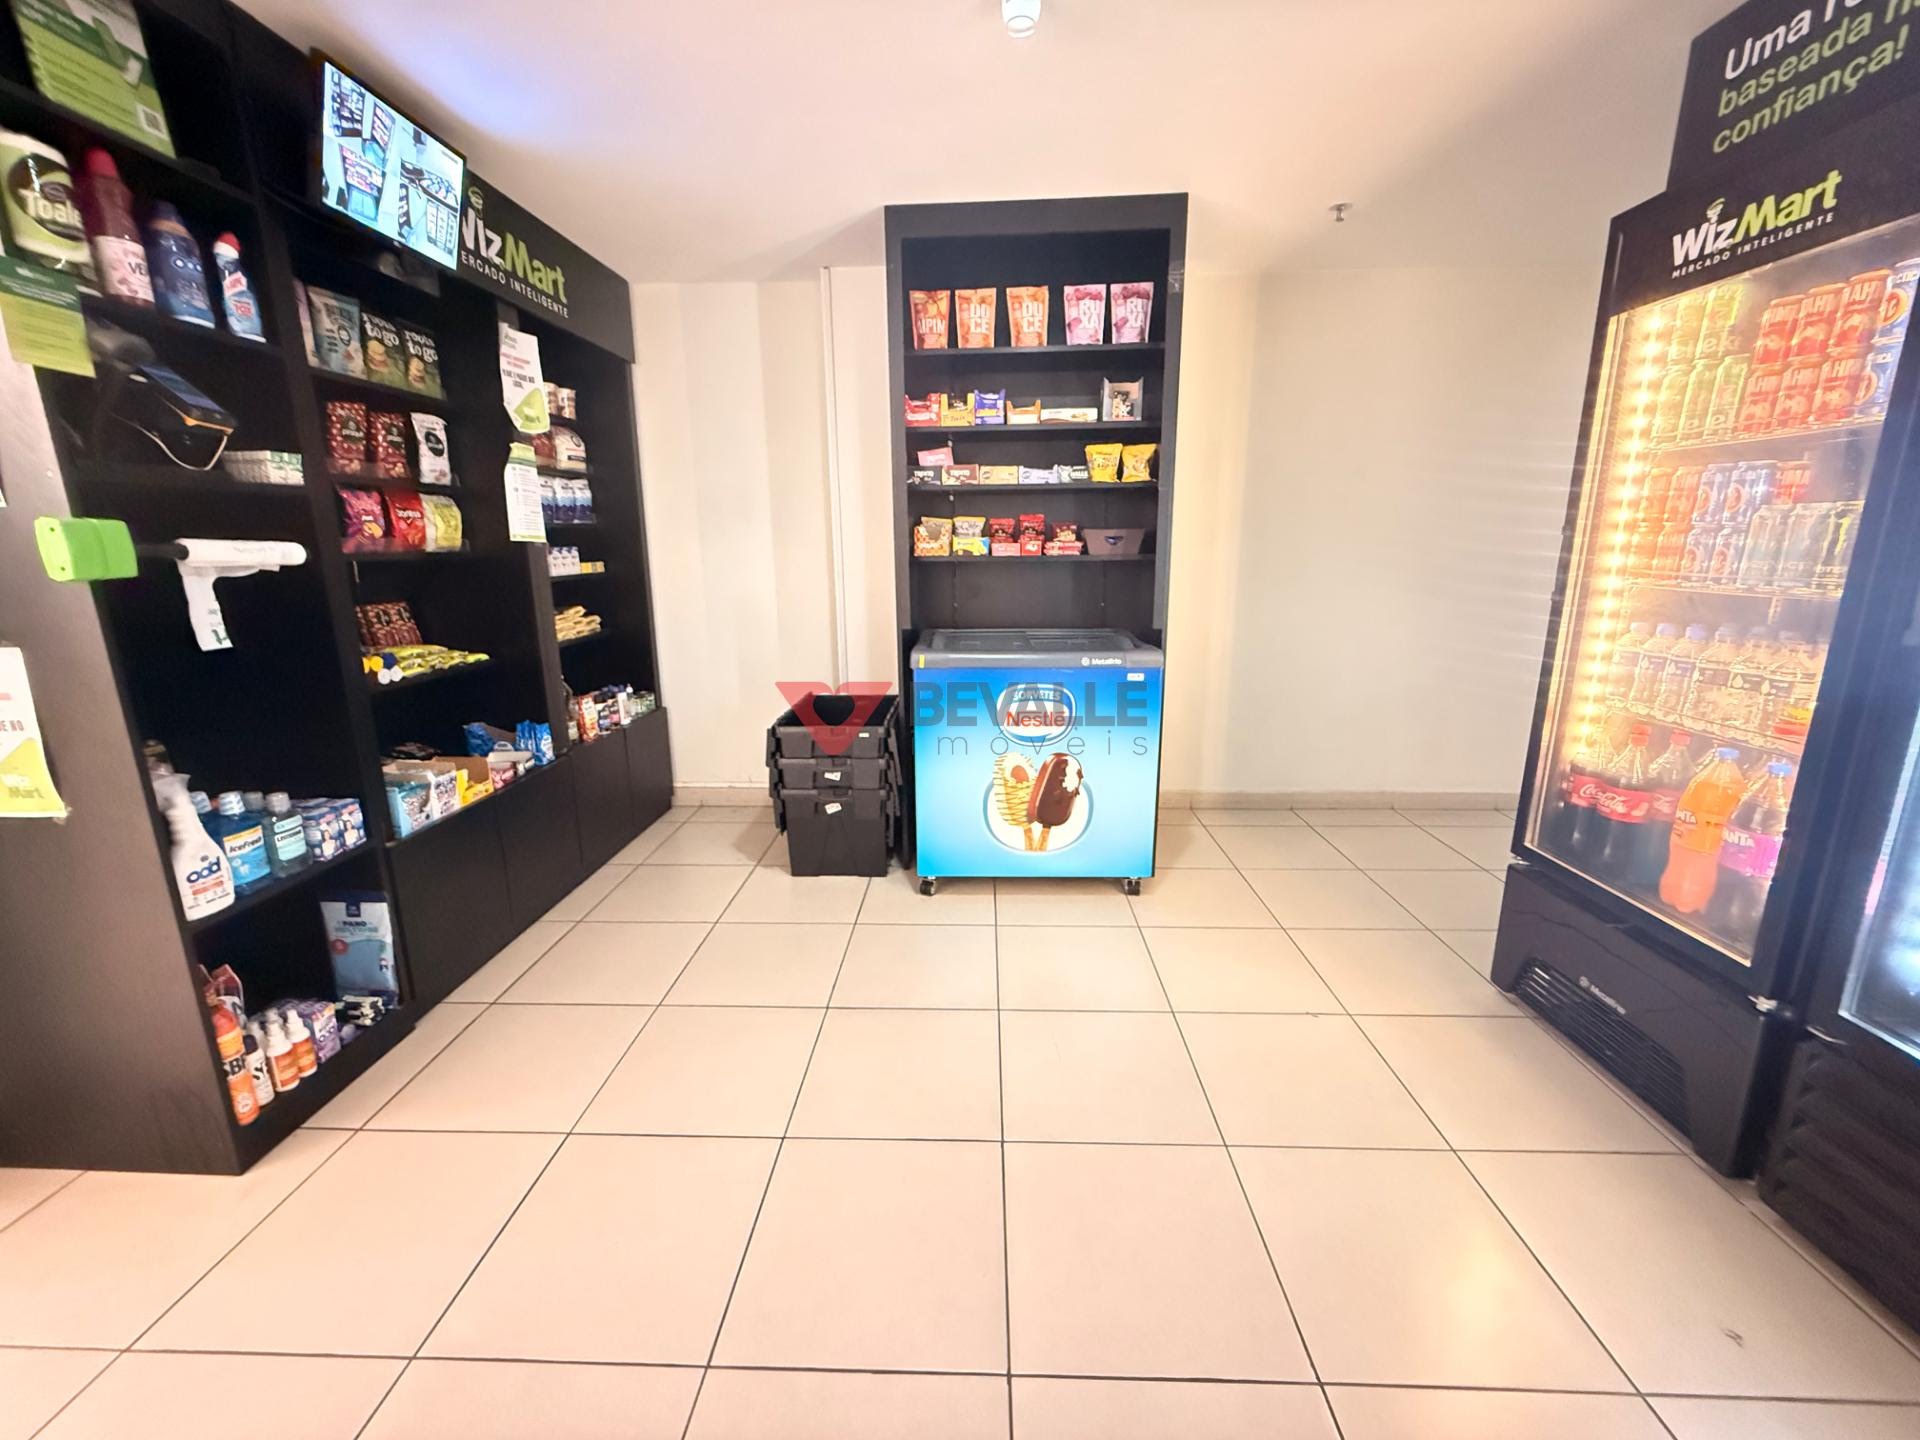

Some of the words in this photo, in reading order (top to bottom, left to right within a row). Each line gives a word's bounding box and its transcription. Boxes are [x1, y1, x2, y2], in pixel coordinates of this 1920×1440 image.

[1718, 11, 1873, 117] baseada
[1725, 9, 1812, 80] Uma
[1712, 24, 1909, 153] confiança!
[1671, 250, 1731, 280] MERCADO
[1737, 212, 1835, 256] INTELIGENTE
[1672, 169, 1842, 267] WizMart
[461, 249, 505, 284] ERCADO
[509, 277, 569, 319] INTELIGENTE
[1721, 827, 1756, 848] ANTA
